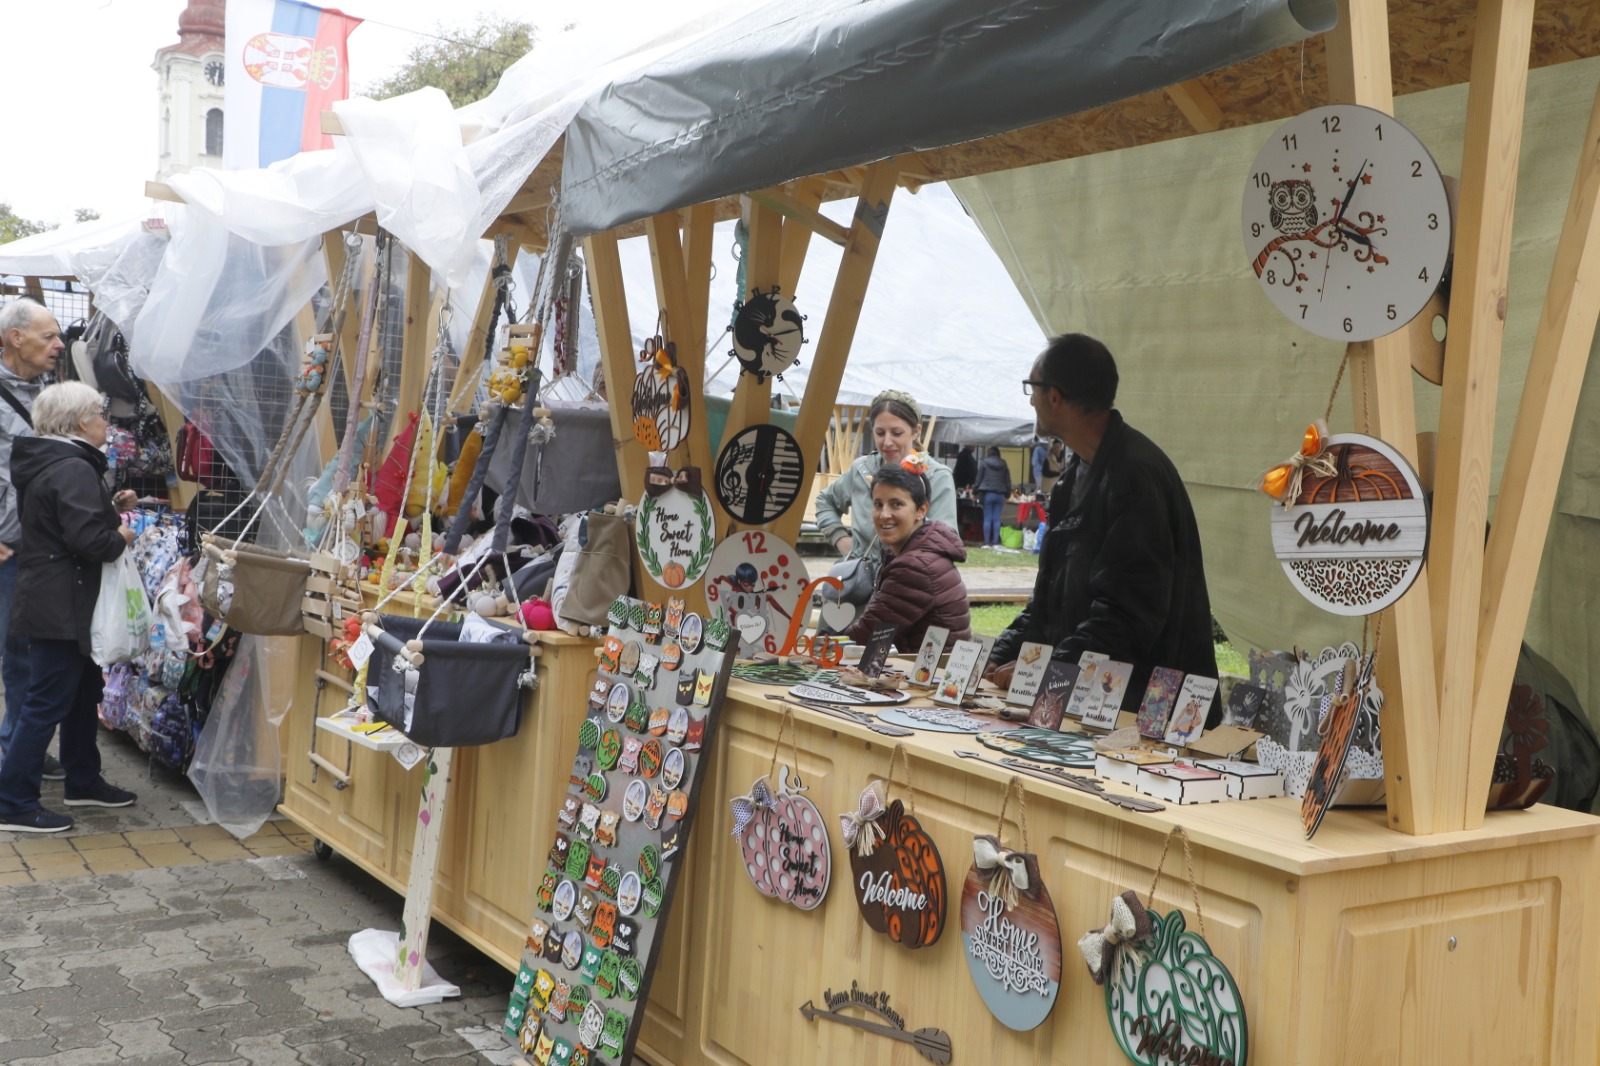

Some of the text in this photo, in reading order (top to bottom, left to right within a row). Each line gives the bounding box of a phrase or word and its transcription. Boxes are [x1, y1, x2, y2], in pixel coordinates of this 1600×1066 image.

[1321, 115, 1341, 133] 12
[1374, 124, 1383, 141] 1
[1281, 134, 1298, 151] 11
[1411, 160, 1422, 178] 2
[1252, 172, 1271, 189] 10
[1251, 222, 1261, 238] 9
[1427, 213, 1438, 230] 3
[1267, 269, 1276, 285] 8
[1418, 266, 1429, 283] 4
[1299, 304, 1309, 320] 7
[1386, 304, 1397, 320] 5
[1342, 317, 1353, 333] 6
[656, 506, 680, 523] Home
[660, 520, 694, 543] Sweet
[1294, 508, 1401, 548] Welcome
[670, 541, 694, 557] Home
[742, 531, 767, 554] 12
[707, 585, 719, 601] 9
[764, 634, 776, 654] 6
[780, 822, 805, 845] Home
[782, 846, 819, 878] Sweet
[794, 876, 821, 898] Home
[860, 871, 928, 911] Welcome
[978, 890, 1040, 956] Home
[975, 924, 1043, 974] SWEET HOME
[850, 979, 879, 1008] Sweet
